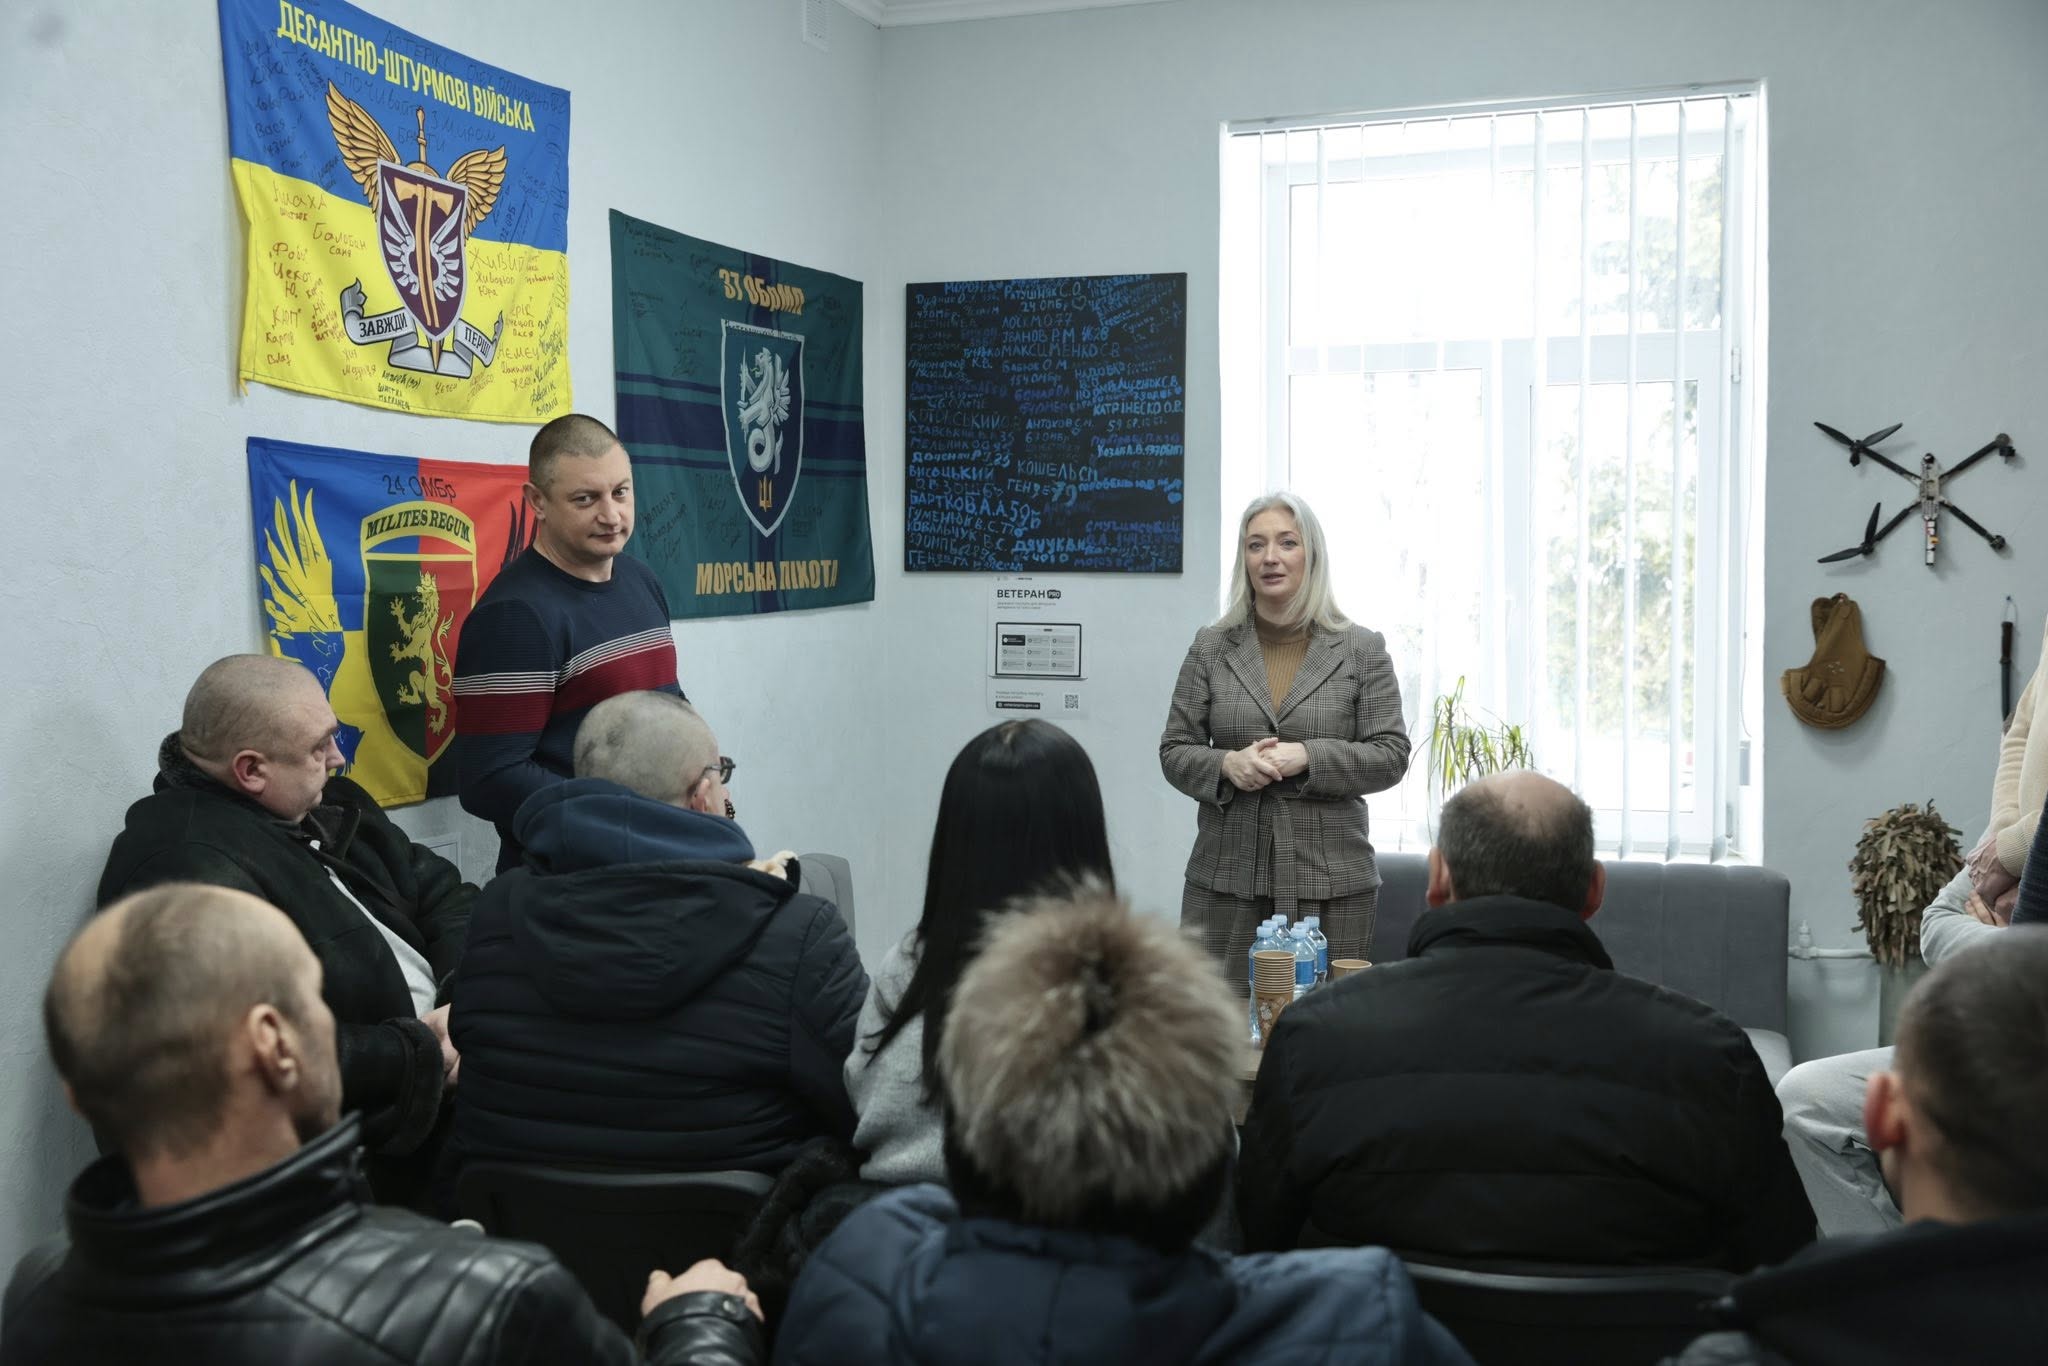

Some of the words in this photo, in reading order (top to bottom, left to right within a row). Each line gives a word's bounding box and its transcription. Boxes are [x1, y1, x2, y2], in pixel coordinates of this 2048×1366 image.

[276, 1, 471, 113] ДЕСАНТНО-ШТУРМОВІ
[472, 86, 536, 132] ВІЙСЬКА
[719, 268, 744, 300] 37
[359, 312, 408, 338] ЗАВЖДИ
[382, 474, 406, 495] 24
[408, 476, 457, 503] ОМБр
[366, 509, 428, 540] MILITES
[430, 510, 471, 543] REGUM
[695, 561, 777, 595] МОРСЬКА
[997, 589, 1045, 598] ВЕТЕРАН
